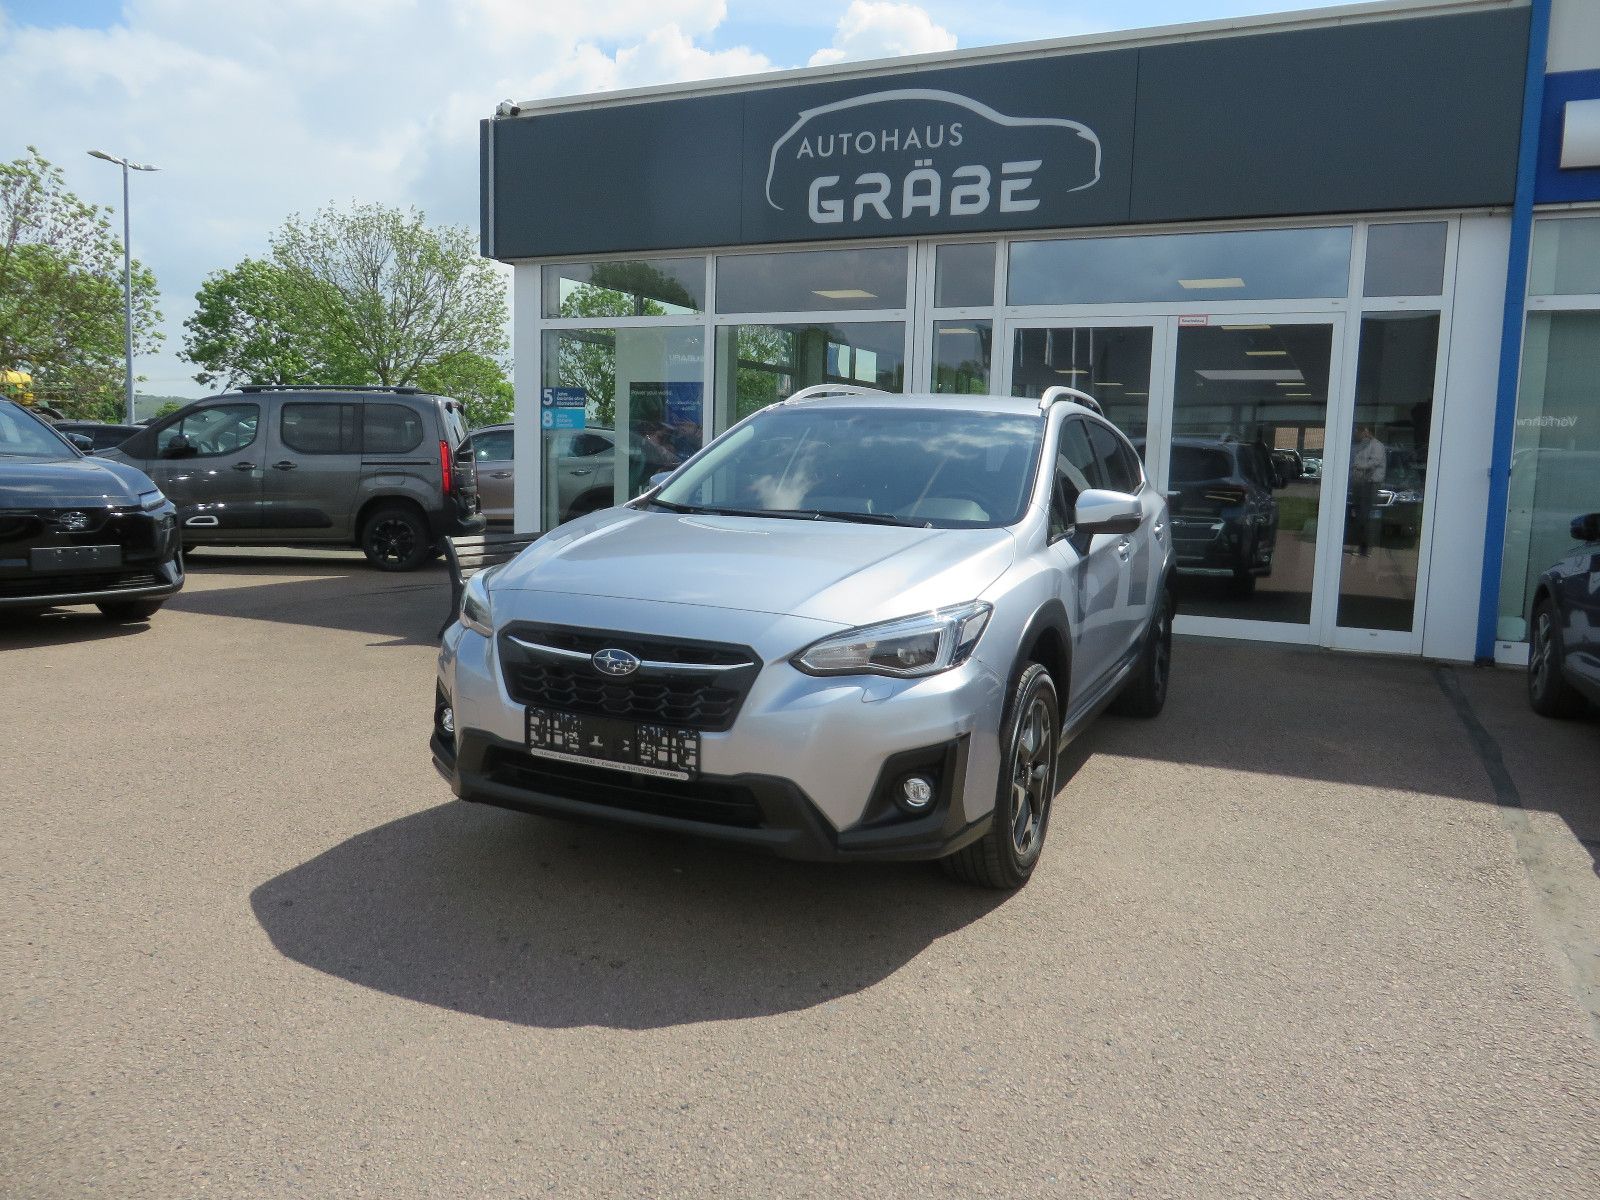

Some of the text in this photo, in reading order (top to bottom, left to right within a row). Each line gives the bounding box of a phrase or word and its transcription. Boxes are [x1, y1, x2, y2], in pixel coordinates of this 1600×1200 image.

[796, 122, 963, 159] AUTOHAUS
[808, 158, 1043, 224] GRÄBE
[542, 388, 553, 406] 5
[542, 410, 553, 428] 8
